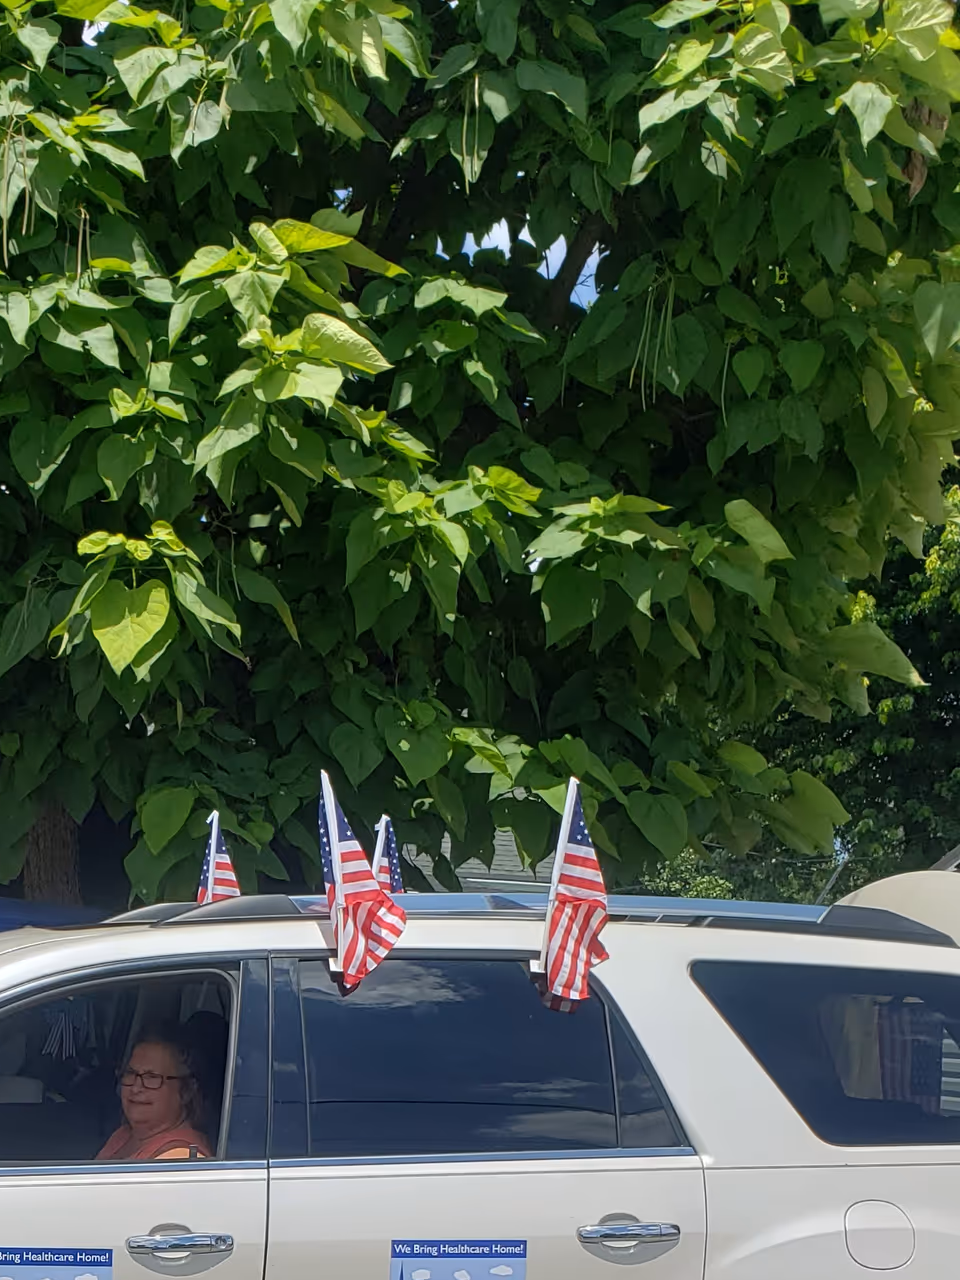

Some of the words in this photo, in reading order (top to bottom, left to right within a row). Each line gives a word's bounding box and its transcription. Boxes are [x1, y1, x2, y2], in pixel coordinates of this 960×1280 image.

[394, 1244, 411, 1254] We
[413, 1244, 438, 1256] Bring
[440, 1244, 490, 1254] Healthcare
[492, 1244, 524, 1254] Home!
[23, 1251, 74, 1262] Healthcare
[76, 1252, 109, 1263] Home!
